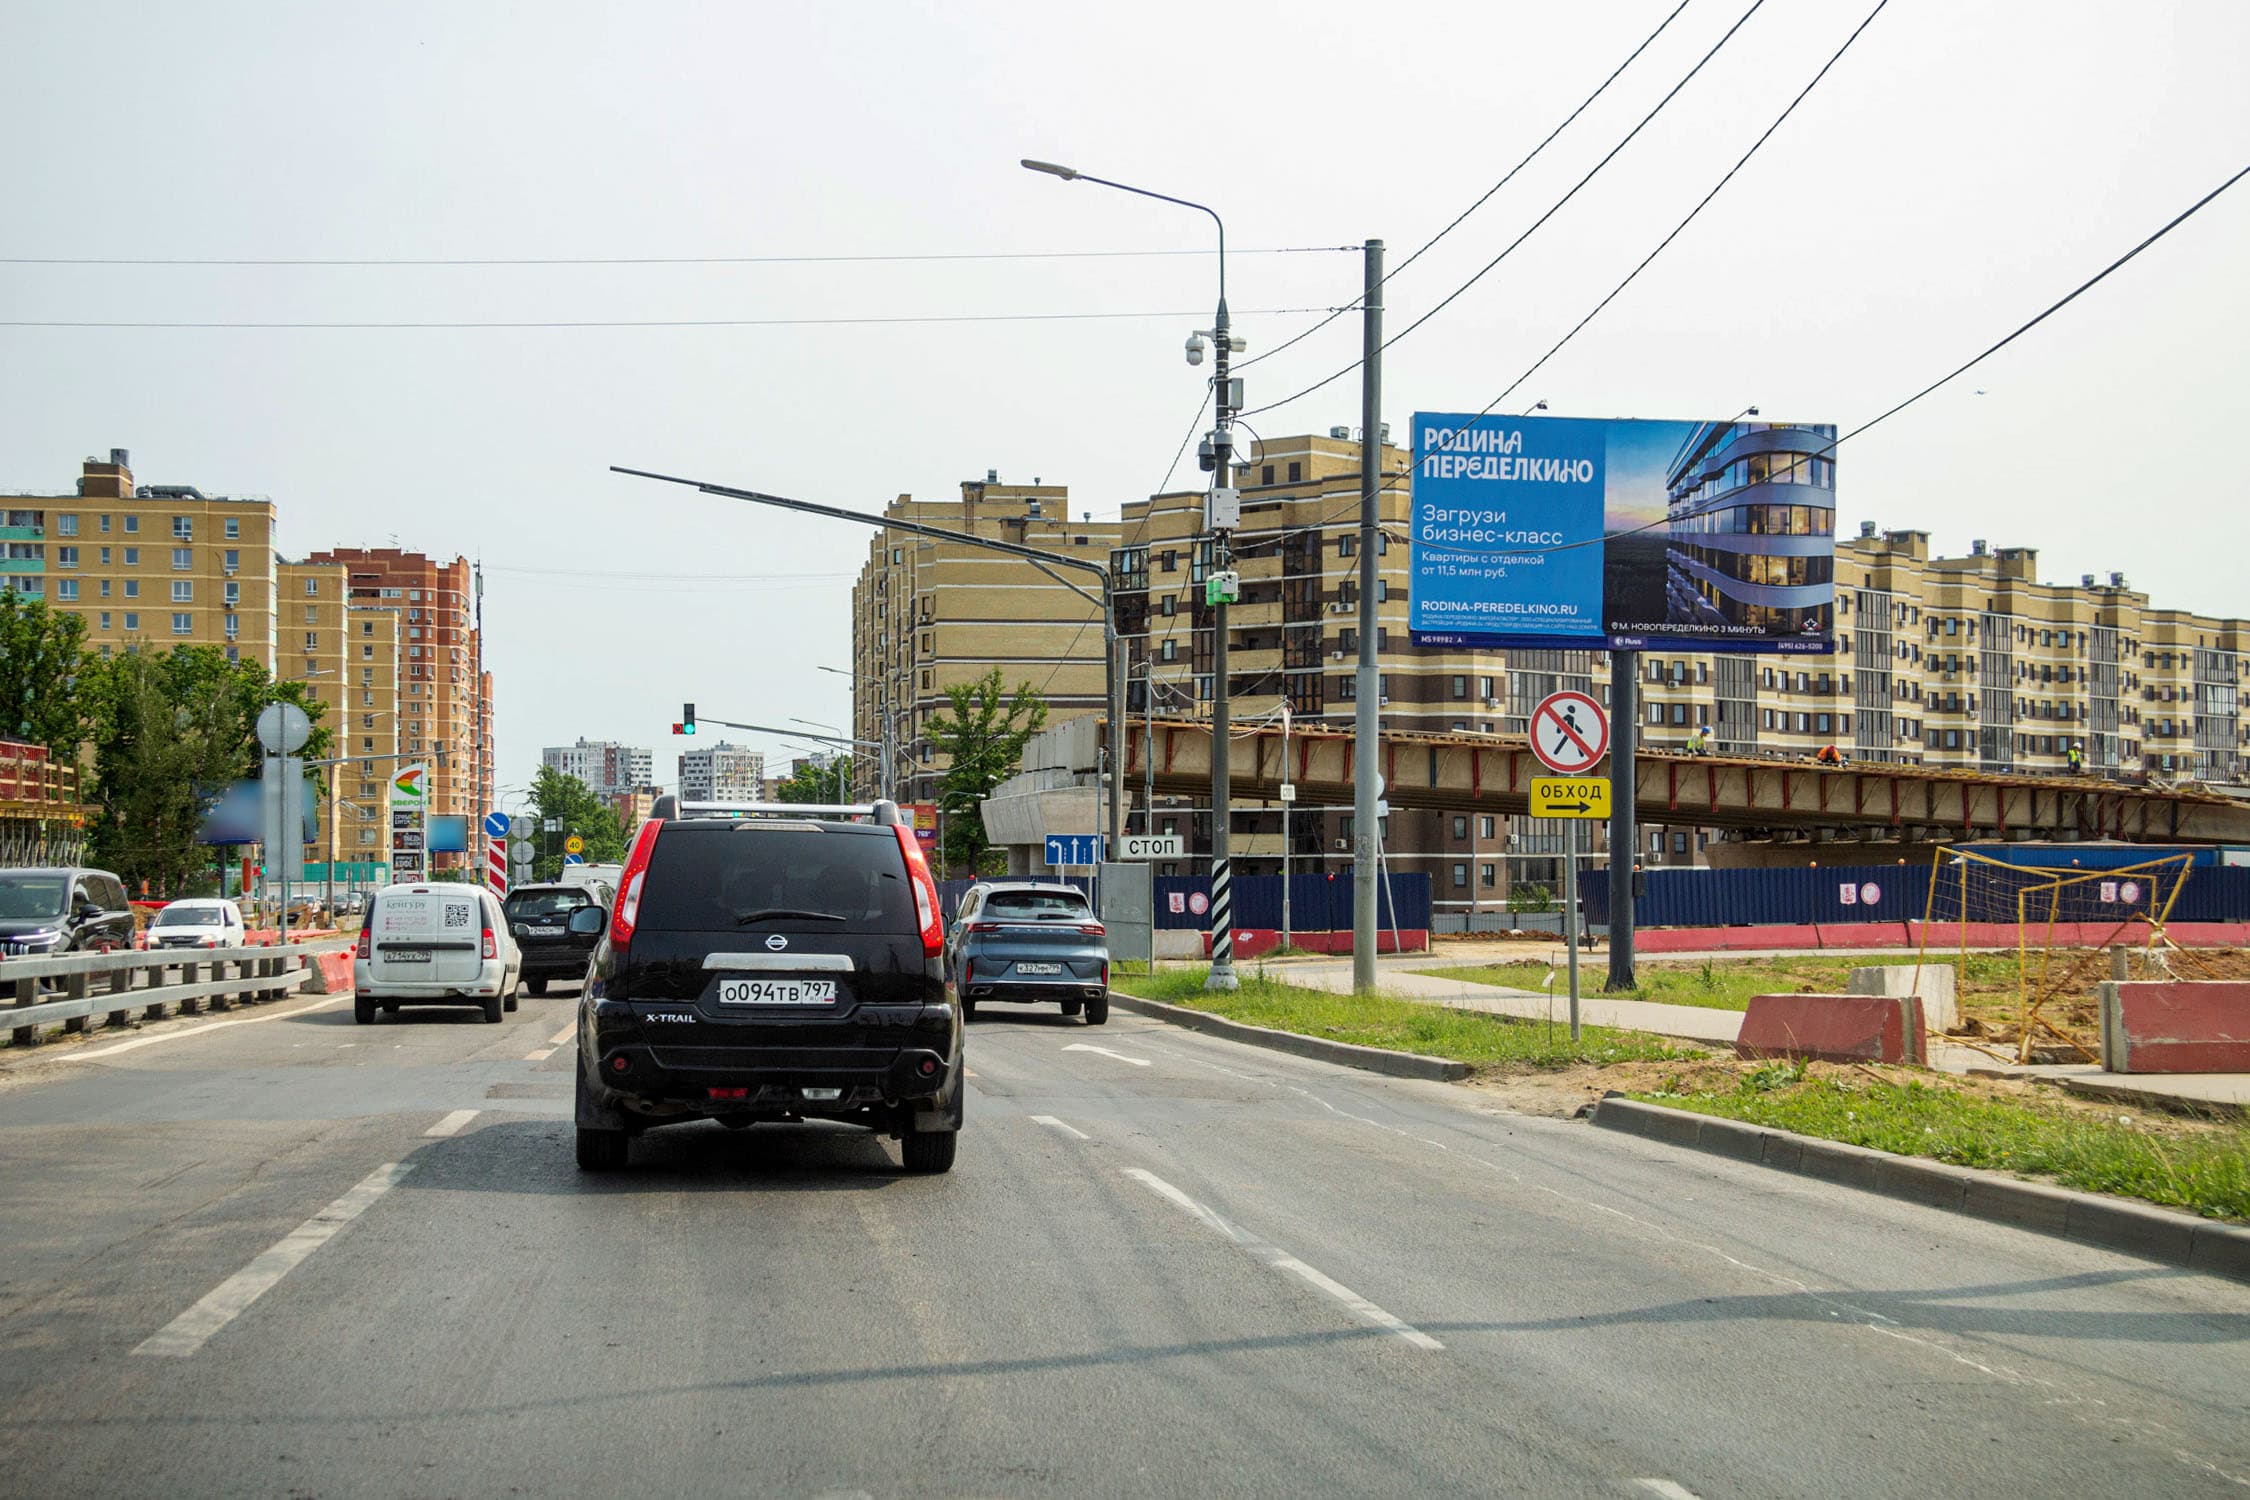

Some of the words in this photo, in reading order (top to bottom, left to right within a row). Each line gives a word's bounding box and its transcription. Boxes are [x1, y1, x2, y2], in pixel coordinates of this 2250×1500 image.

[1424, 427, 1522, 454] РОДИНА
[1423, 455, 1594, 484] ПЕРЕДЕЛКИНО
[1422, 504, 1506, 526] Загрузи
[1422, 524, 1563, 545] бизнес-класс
[1421, 552, 1479, 564] Квартиры
[1481, 556, 1488, 564] с
[1490, 554, 1545, 565] отделкой
[1421, 567, 1434, 575] от
[1437, 566, 1456, 576] 11,5
[1484, 568, 1508, 579] руб.
[1421, 600, 1578, 616] RODINA-PEREDELKINO.RU
[1619, 622, 1629, 630] М.
[1631, 623, 1719, 633] НОВОПЕРЕДЕЛКИНО
[1720, 625, 1726, 633] 3
[1727, 625, 1766, 634] МИНУТЫ
[1541, 784, 1602, 800] ОБХОД
[569, 841, 581, 849] 40
[1129, 840, 1175, 854] СТОП
[725, 983, 799, 1001] О094ТВ
[803, 982, 831, 997] 797
[646, 1013, 697, 1023] X-TRAIL
